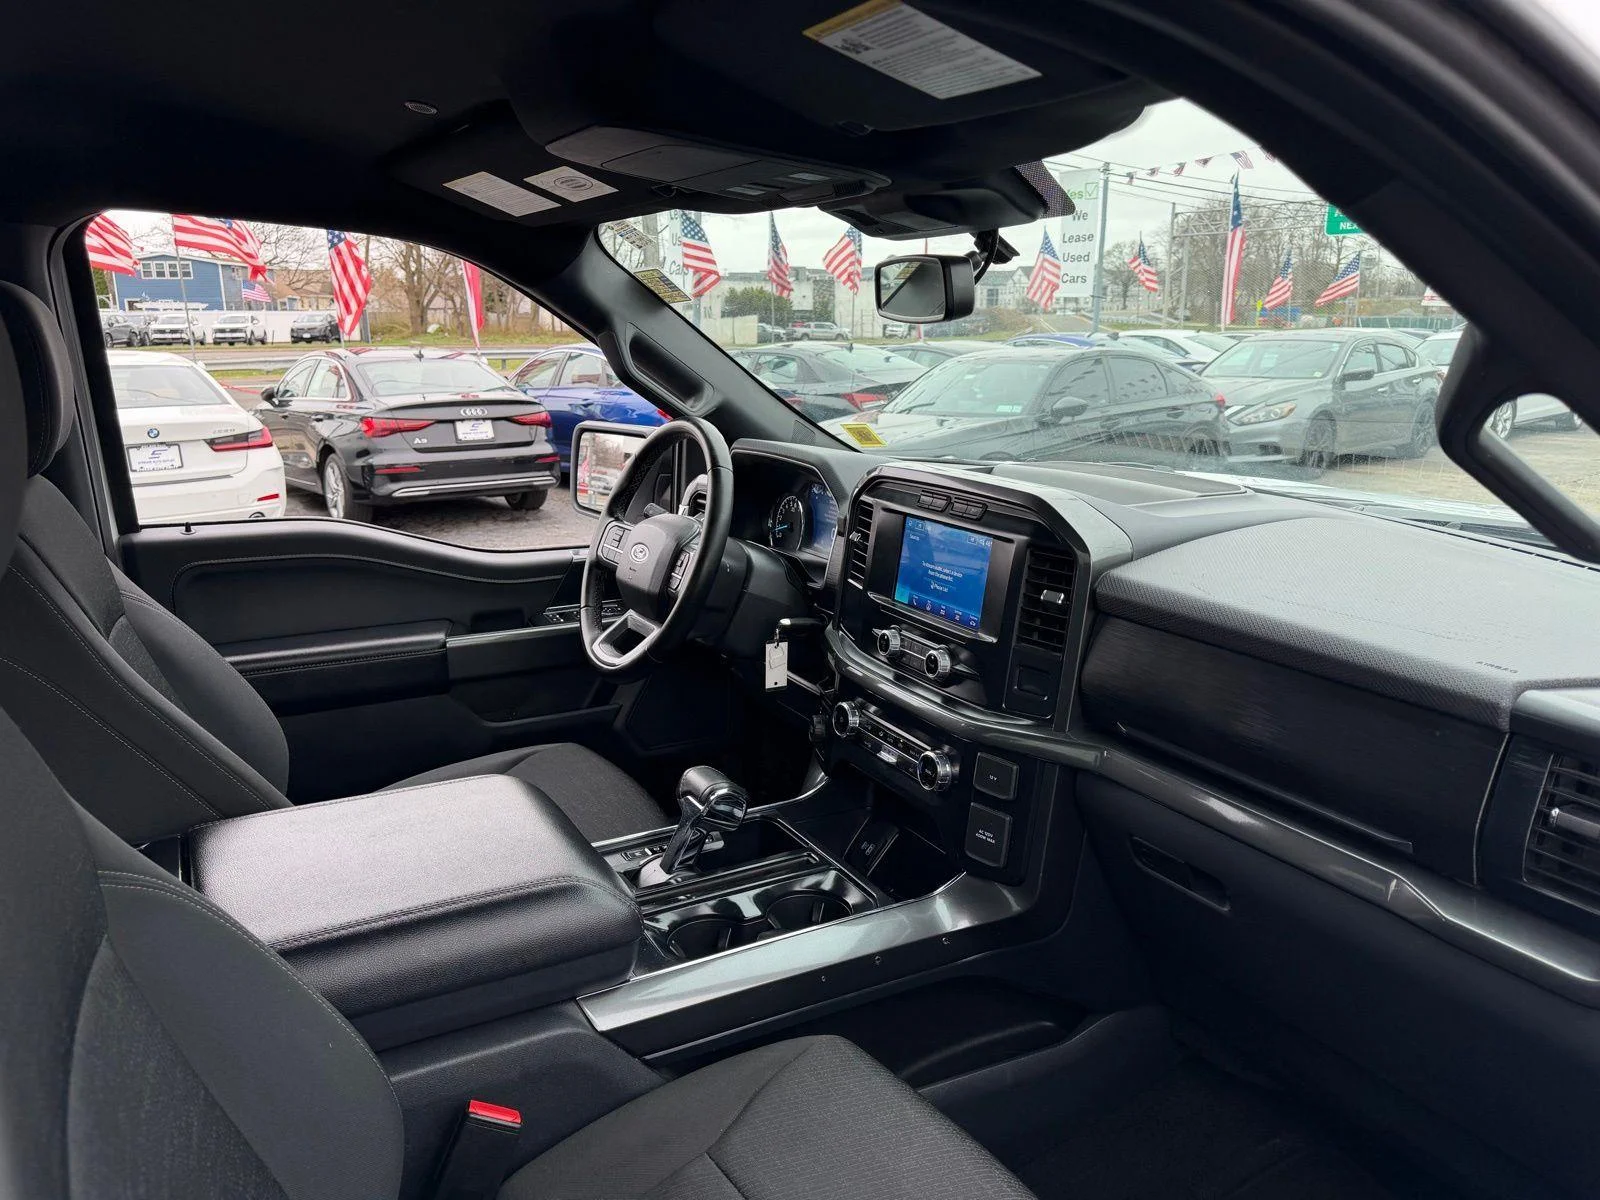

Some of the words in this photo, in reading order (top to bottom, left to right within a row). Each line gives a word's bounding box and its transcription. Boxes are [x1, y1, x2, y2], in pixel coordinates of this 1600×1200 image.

[1339, 221, 1359, 230] NEX
[1062, 233, 1094, 244] Lease
[1062, 252, 1091, 263] Used
[1061, 272, 1087, 284] Cars
[1474, 661, 1519, 674] AIRBAG
